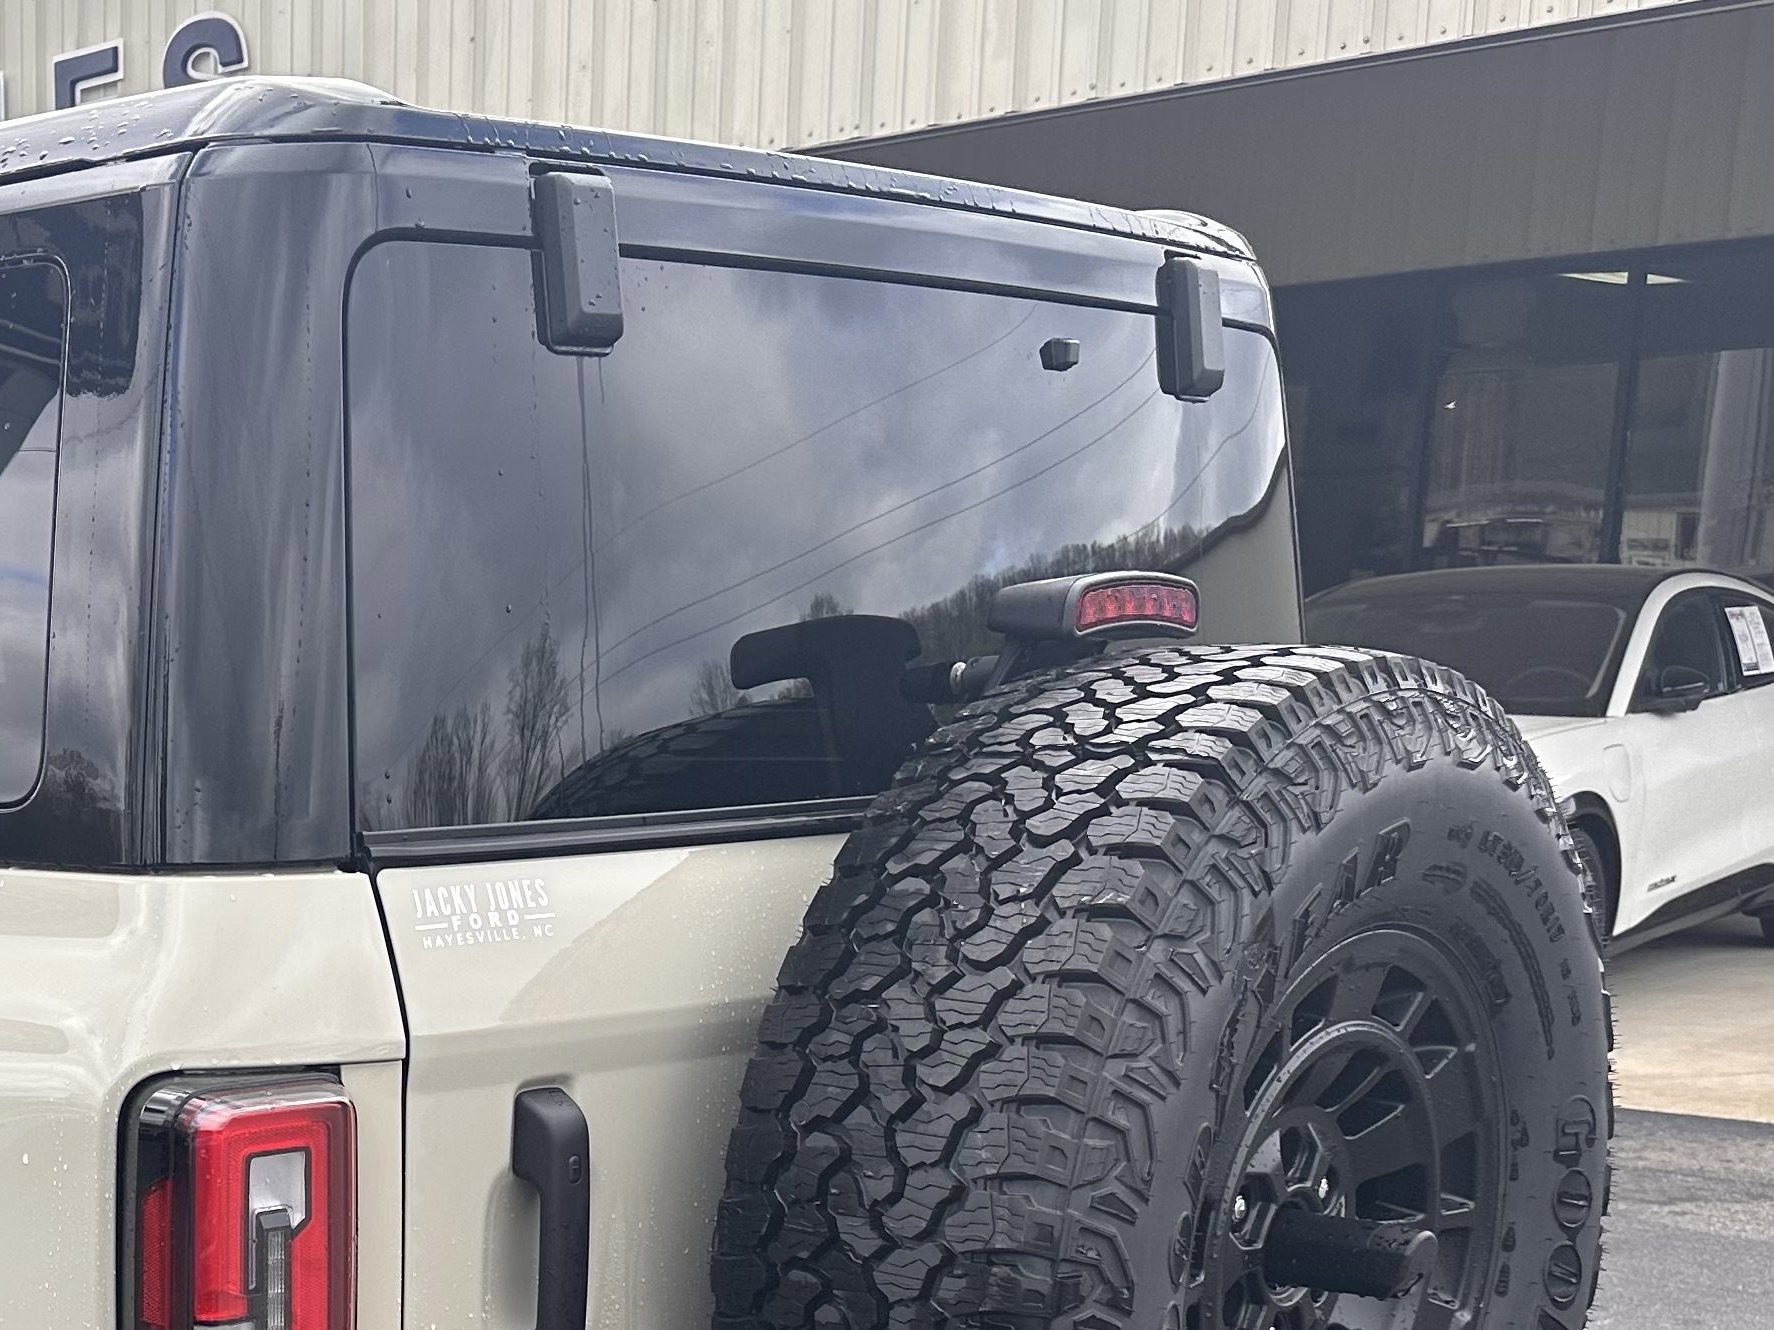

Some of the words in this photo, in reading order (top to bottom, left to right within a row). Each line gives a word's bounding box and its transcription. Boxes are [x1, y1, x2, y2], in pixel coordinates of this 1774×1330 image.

[413, 884, 478, 918] JACKY
[486, 879, 549, 911] JONES
[450, 909, 520, 931] FORD
[533, 924, 554, 938] NC
